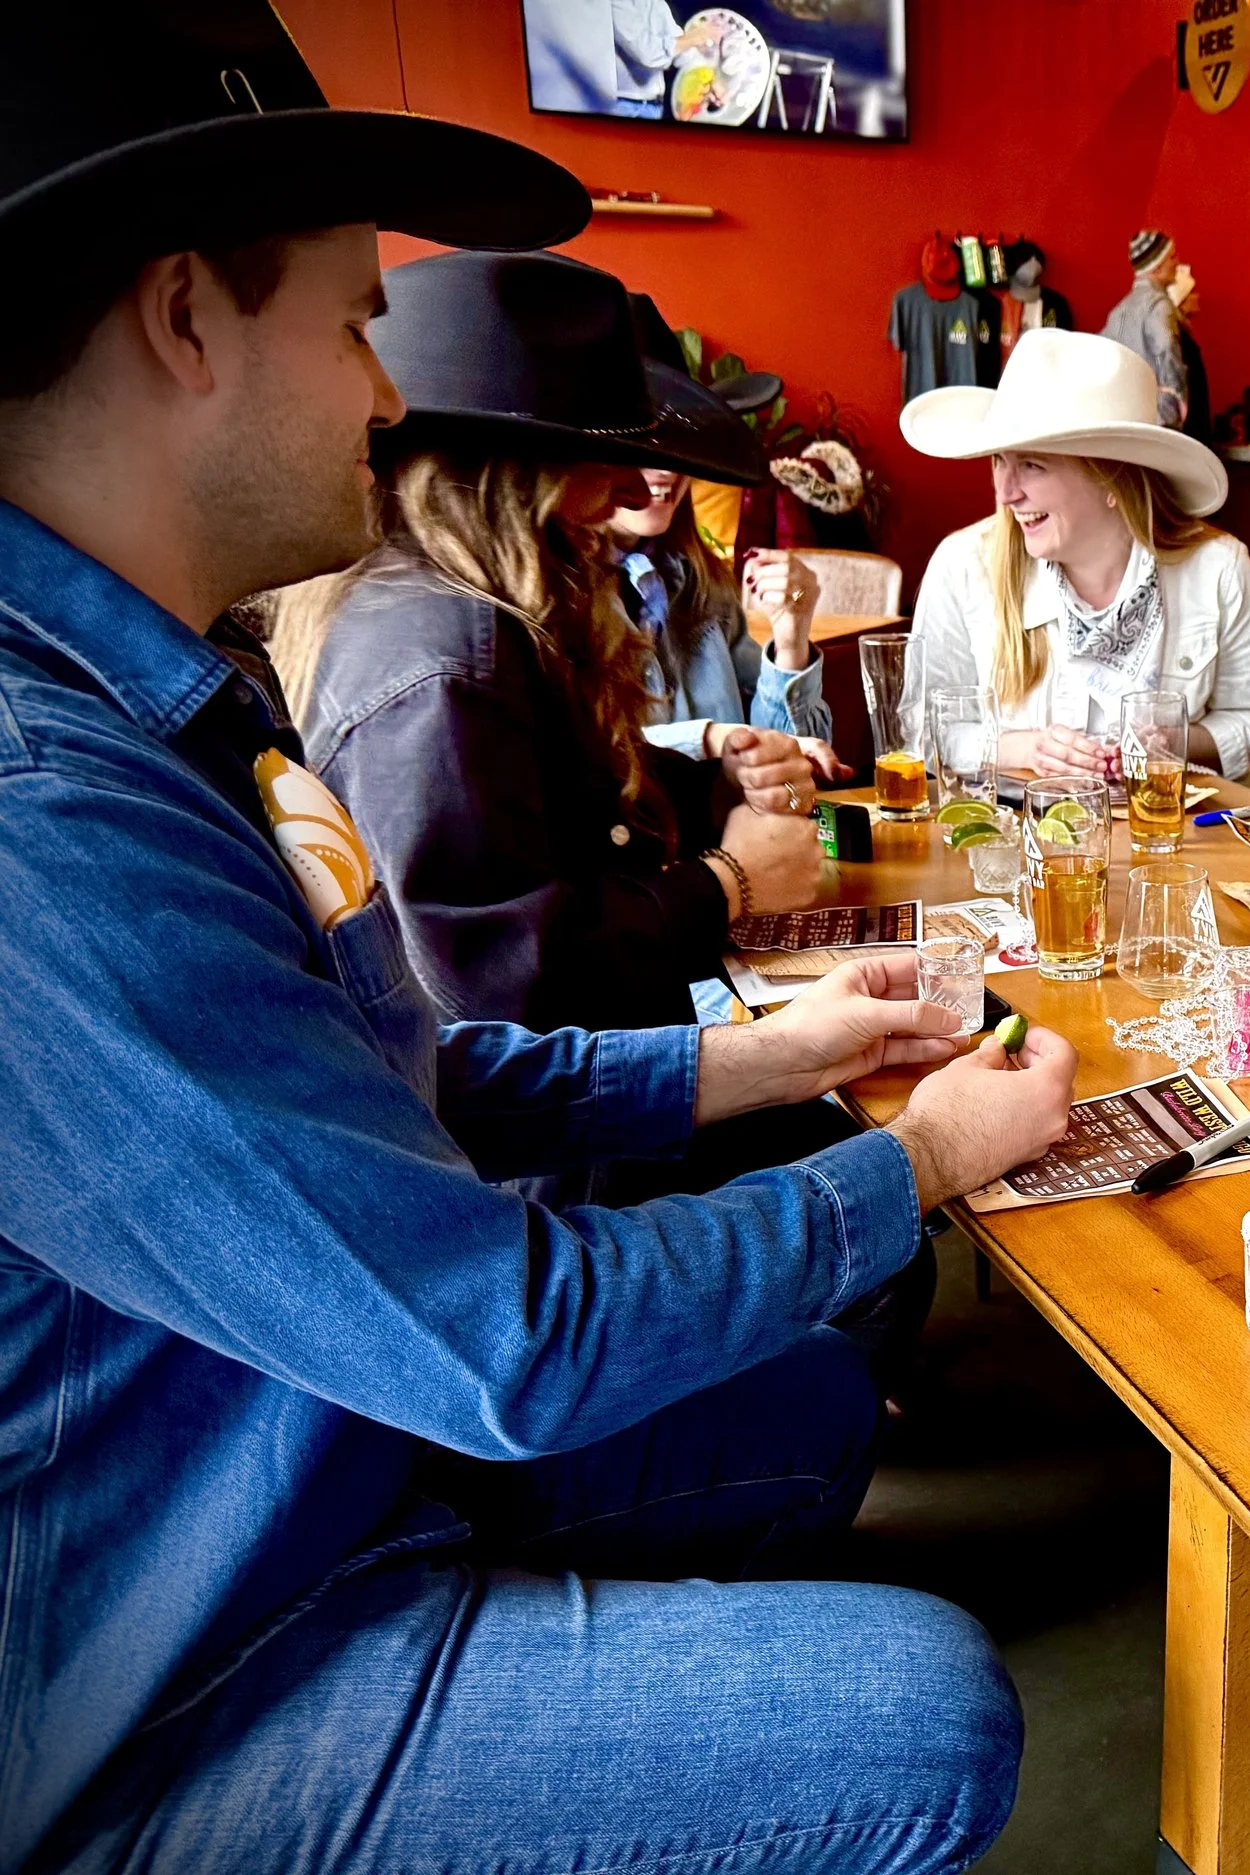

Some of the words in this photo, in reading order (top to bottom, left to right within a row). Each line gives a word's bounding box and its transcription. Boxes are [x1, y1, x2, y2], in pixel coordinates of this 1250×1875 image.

[1194, 0, 1238, 24] ORDER
[1198, 25, 1235, 58] HERE
[1170, 1078, 1202, 1106] WILD
[1193, 1103, 1229, 1132] WEST
